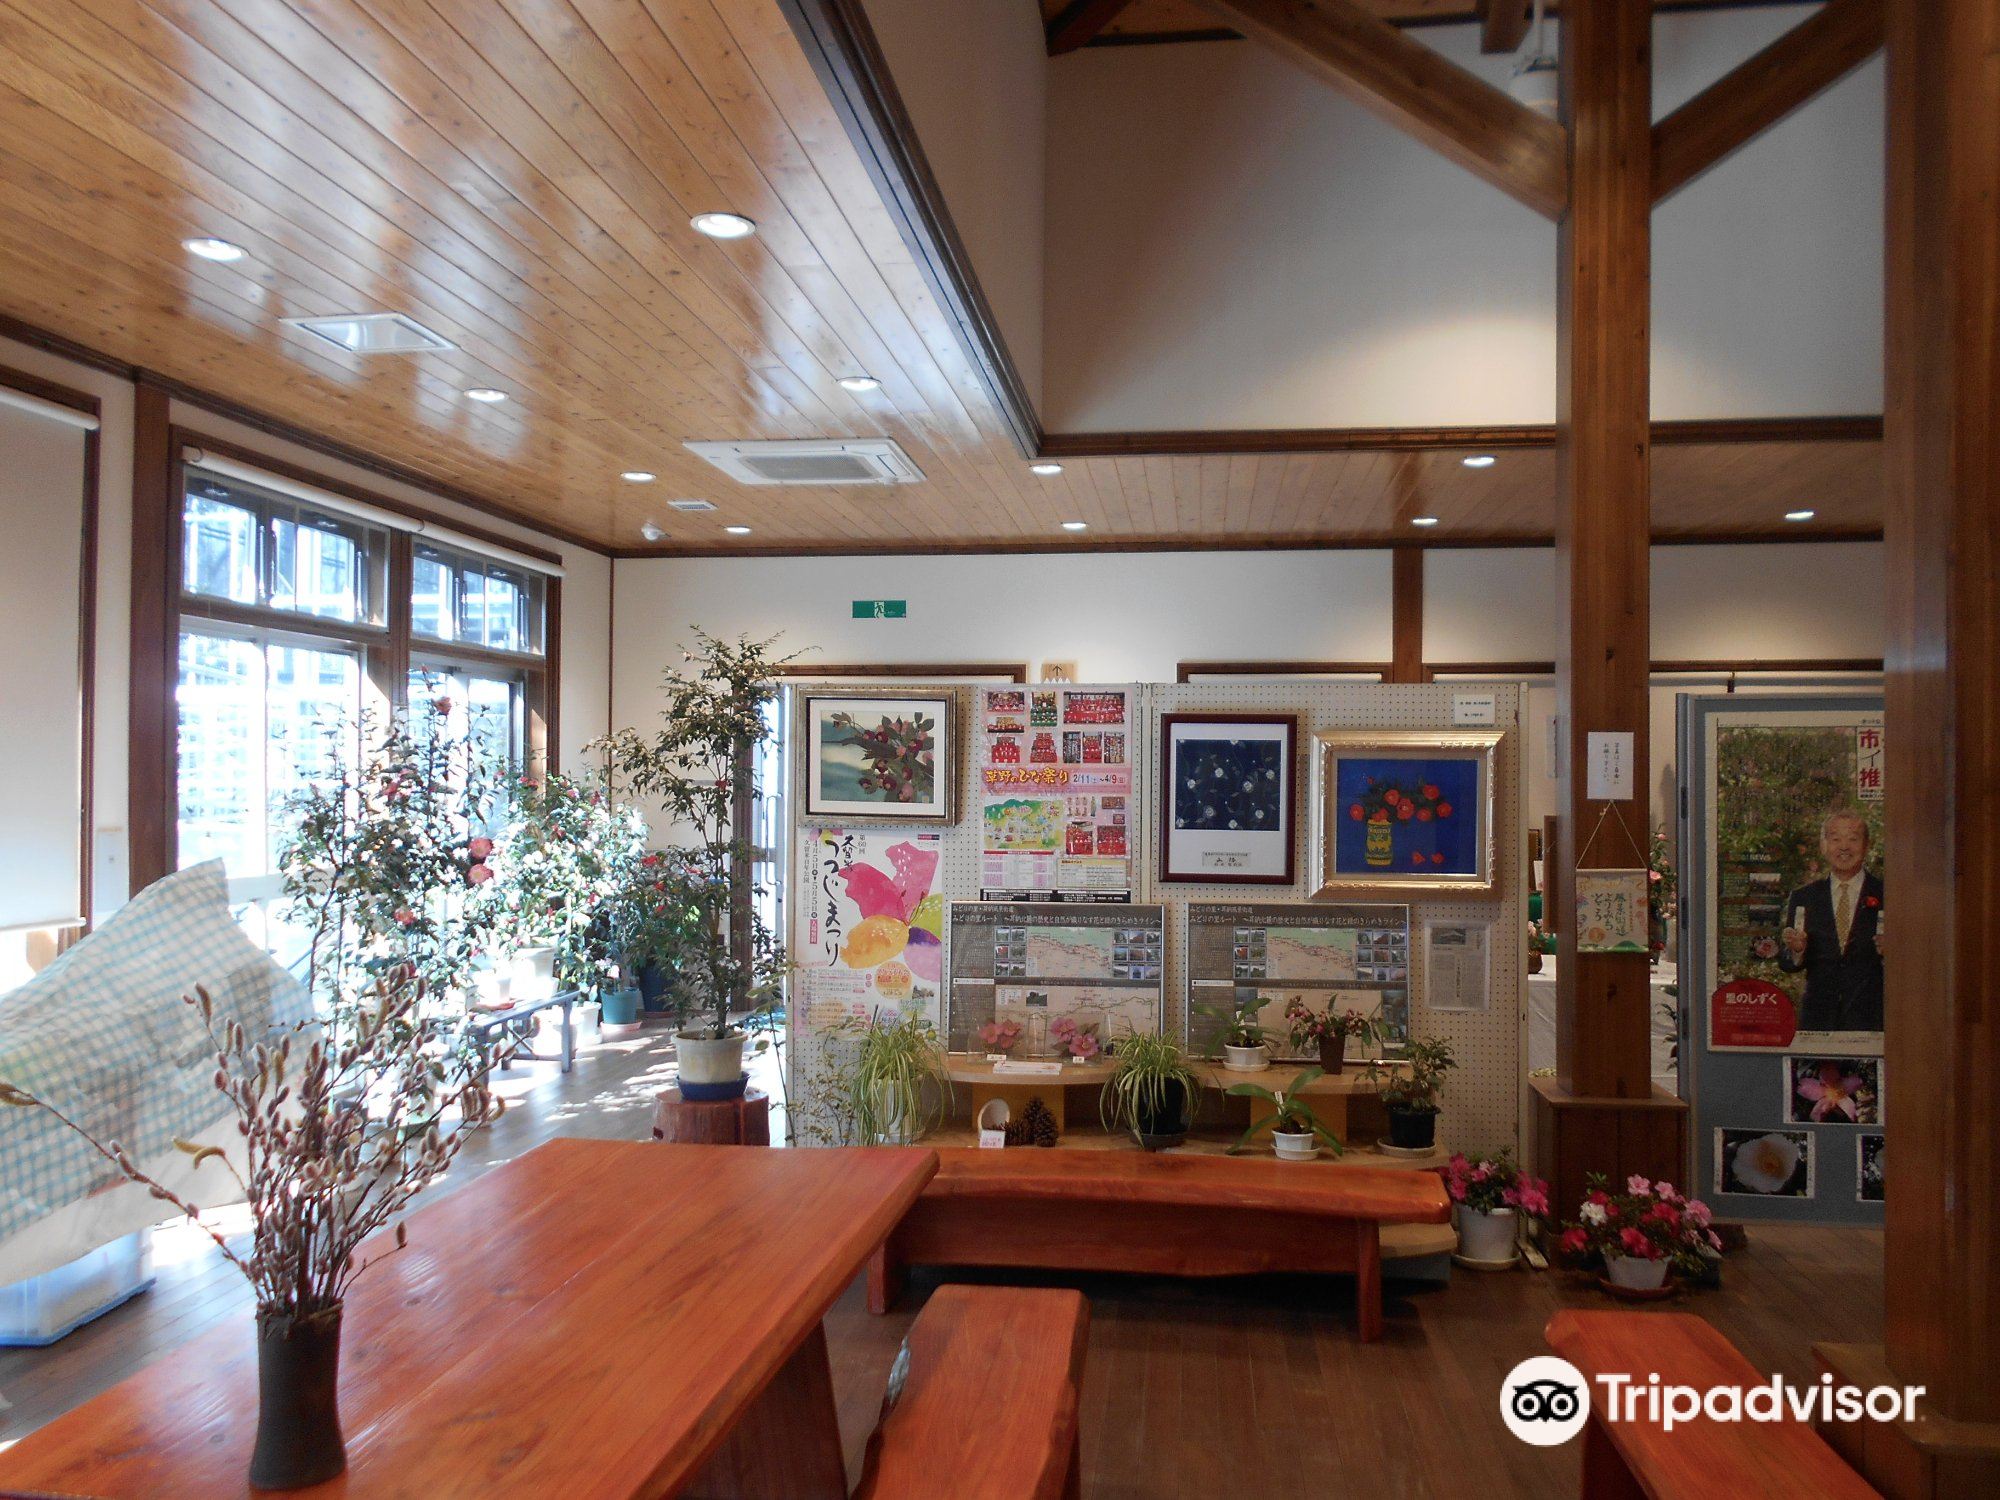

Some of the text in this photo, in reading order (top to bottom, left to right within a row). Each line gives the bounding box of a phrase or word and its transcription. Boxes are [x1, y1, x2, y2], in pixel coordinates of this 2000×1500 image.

[985, 767, 1069, 785] 草野のひな祭り
[822, 838, 842, 967] つつじまつり
[1725, 992, 1778, 1005] 里のしずく
